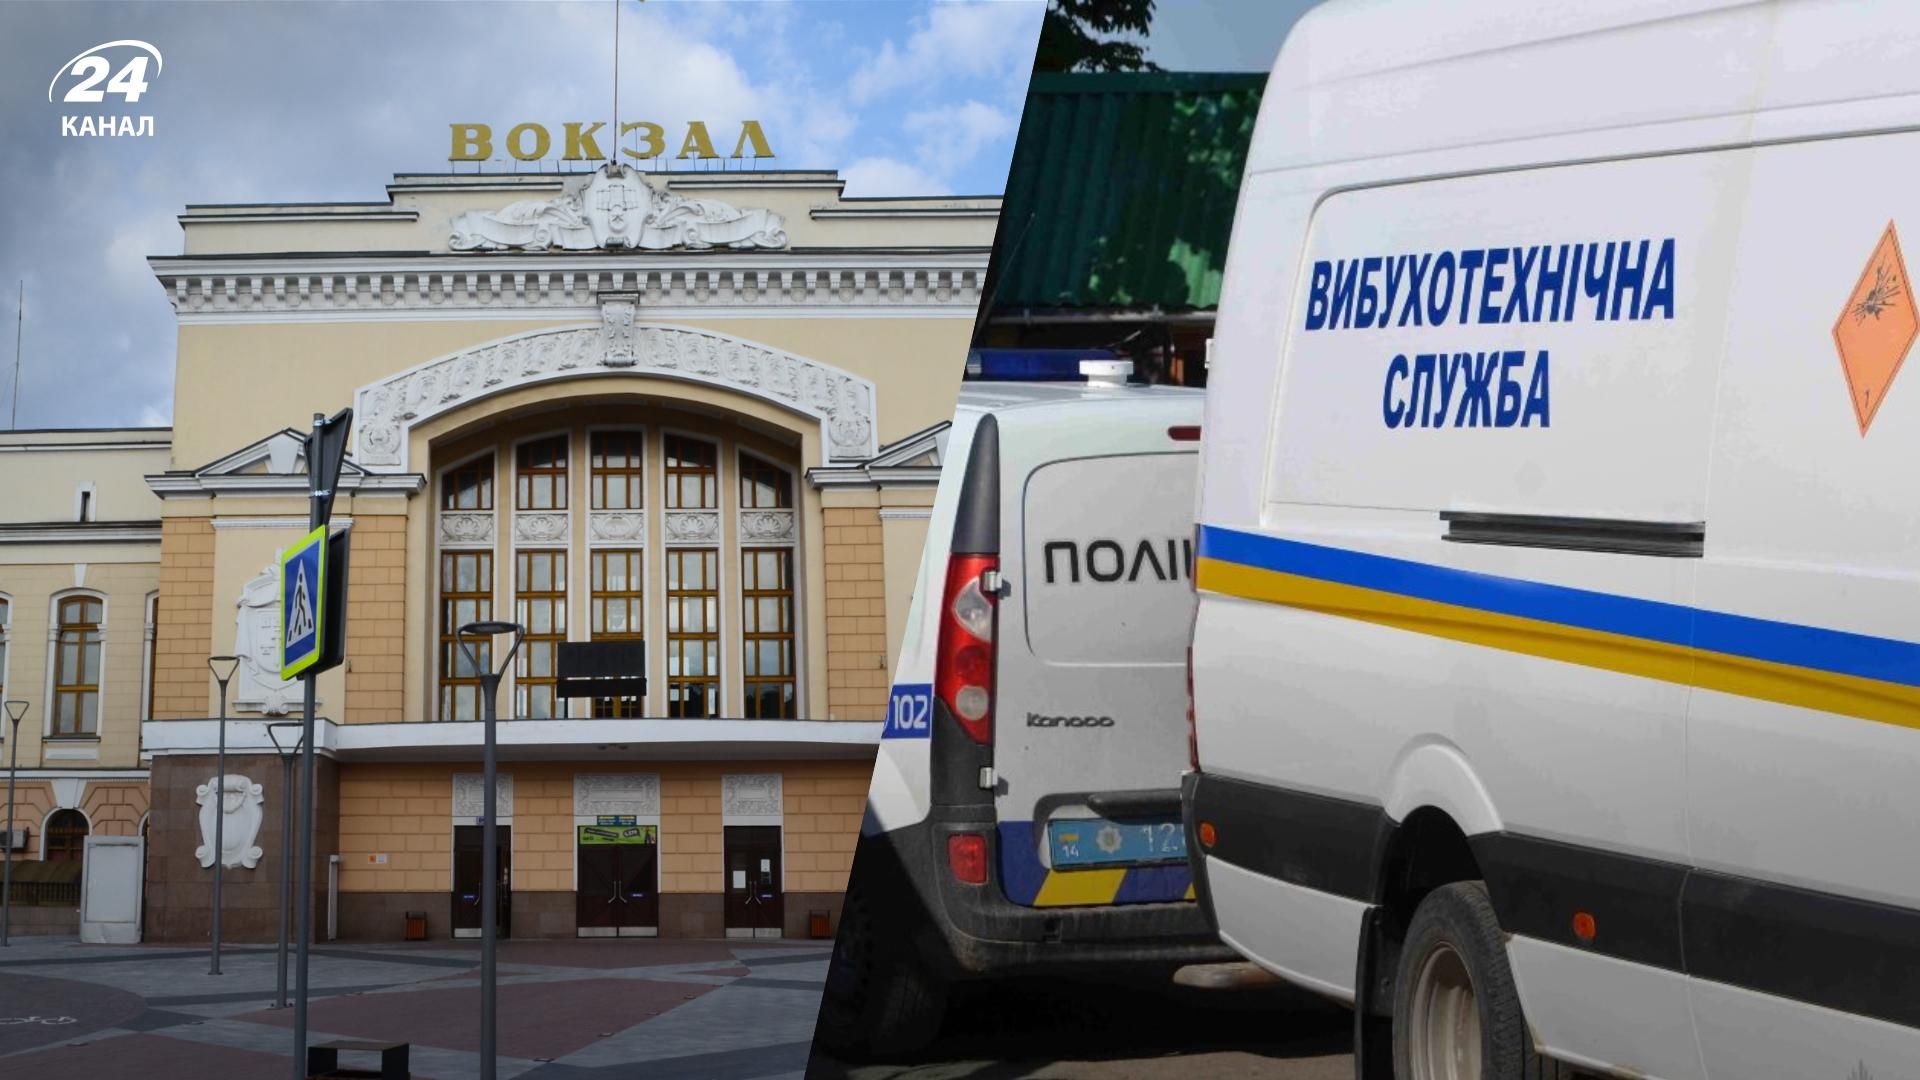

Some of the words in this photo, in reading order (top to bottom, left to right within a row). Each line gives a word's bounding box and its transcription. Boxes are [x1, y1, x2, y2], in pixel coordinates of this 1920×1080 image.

[448, 120, 776, 161] ВОКЗАЛ
[1305, 238, 1676, 331] ВИБУХОТЕХНІЧНА
[1382, 350, 1551, 428] СЛУЖБА
[892, 694, 928, 730] 102
[1142, 822, 1187, 853] 12
